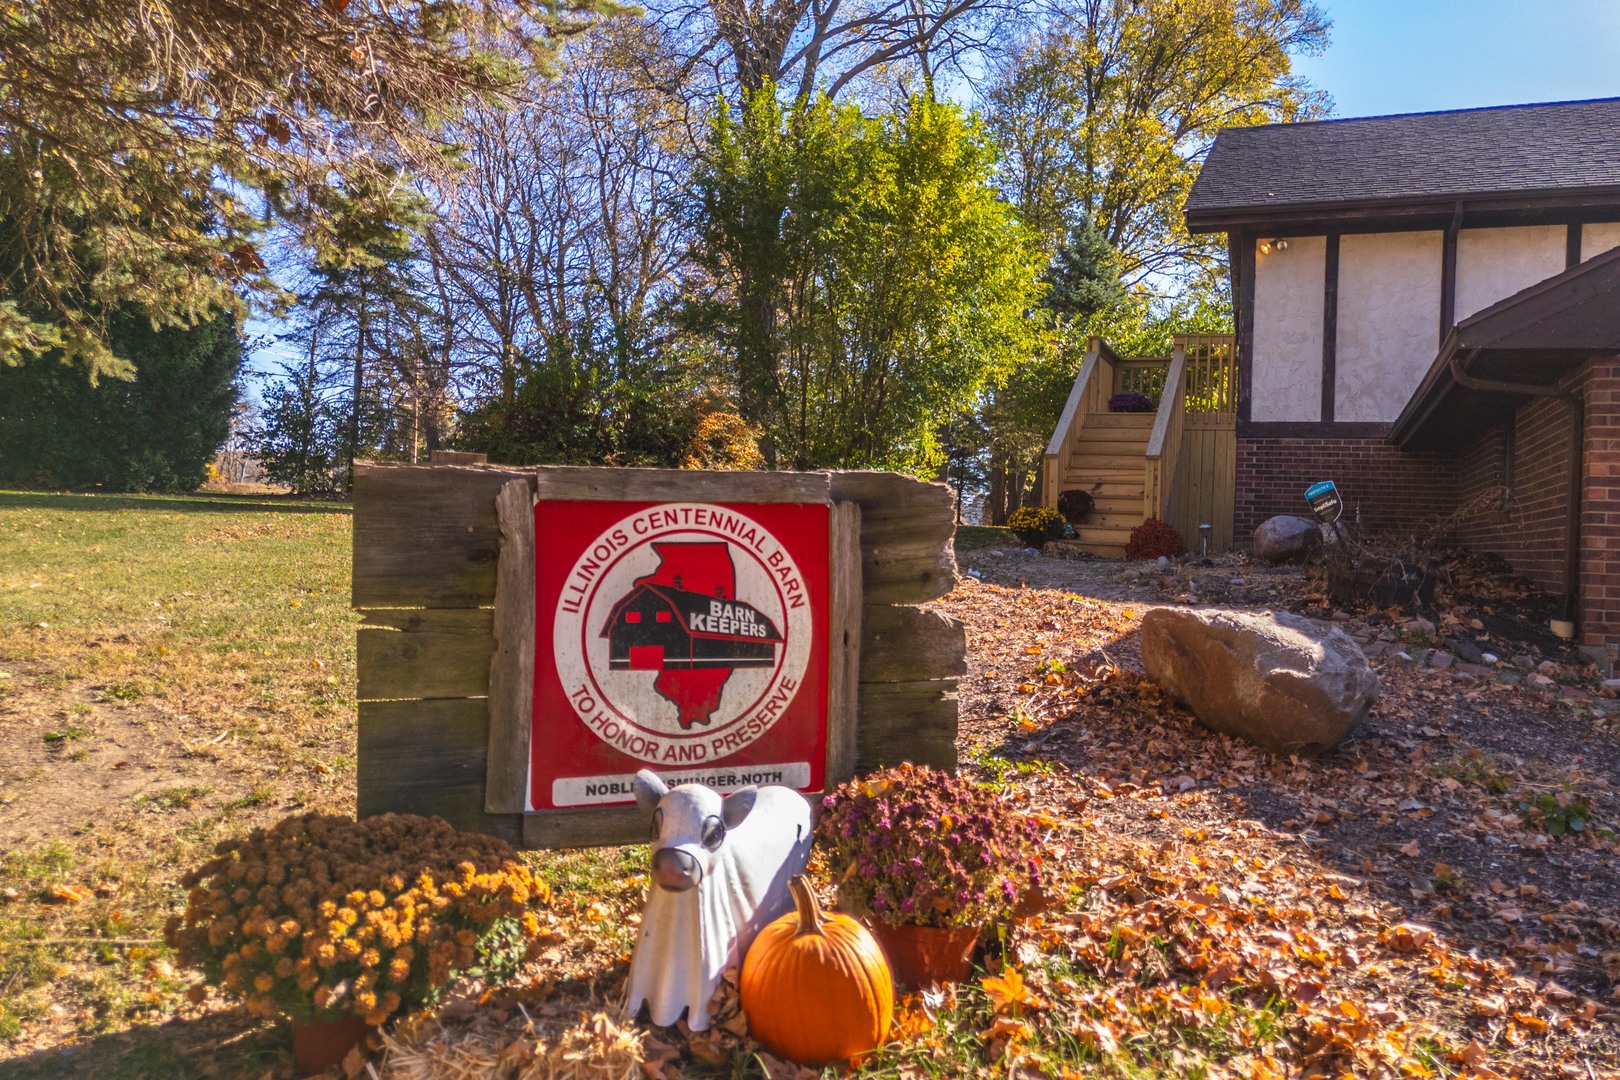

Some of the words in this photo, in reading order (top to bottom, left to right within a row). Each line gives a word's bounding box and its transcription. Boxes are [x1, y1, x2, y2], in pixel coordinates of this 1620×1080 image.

[562, 529, 629, 614] ILLINOIS
[632, 508, 766, 554] CENTENNIAL
[767, 550, 805, 609] BARN
[710, 600, 755, 623] BARN
[689, 612, 767, 638] KEEPERS
[571, 684, 596, 714] TO
[590, 711, 660, 760] HONOR
[663, 744, 707, 762] AND
[712, 676, 797, 756] PRESERVE
[585, 782, 634, 796] NOBL
